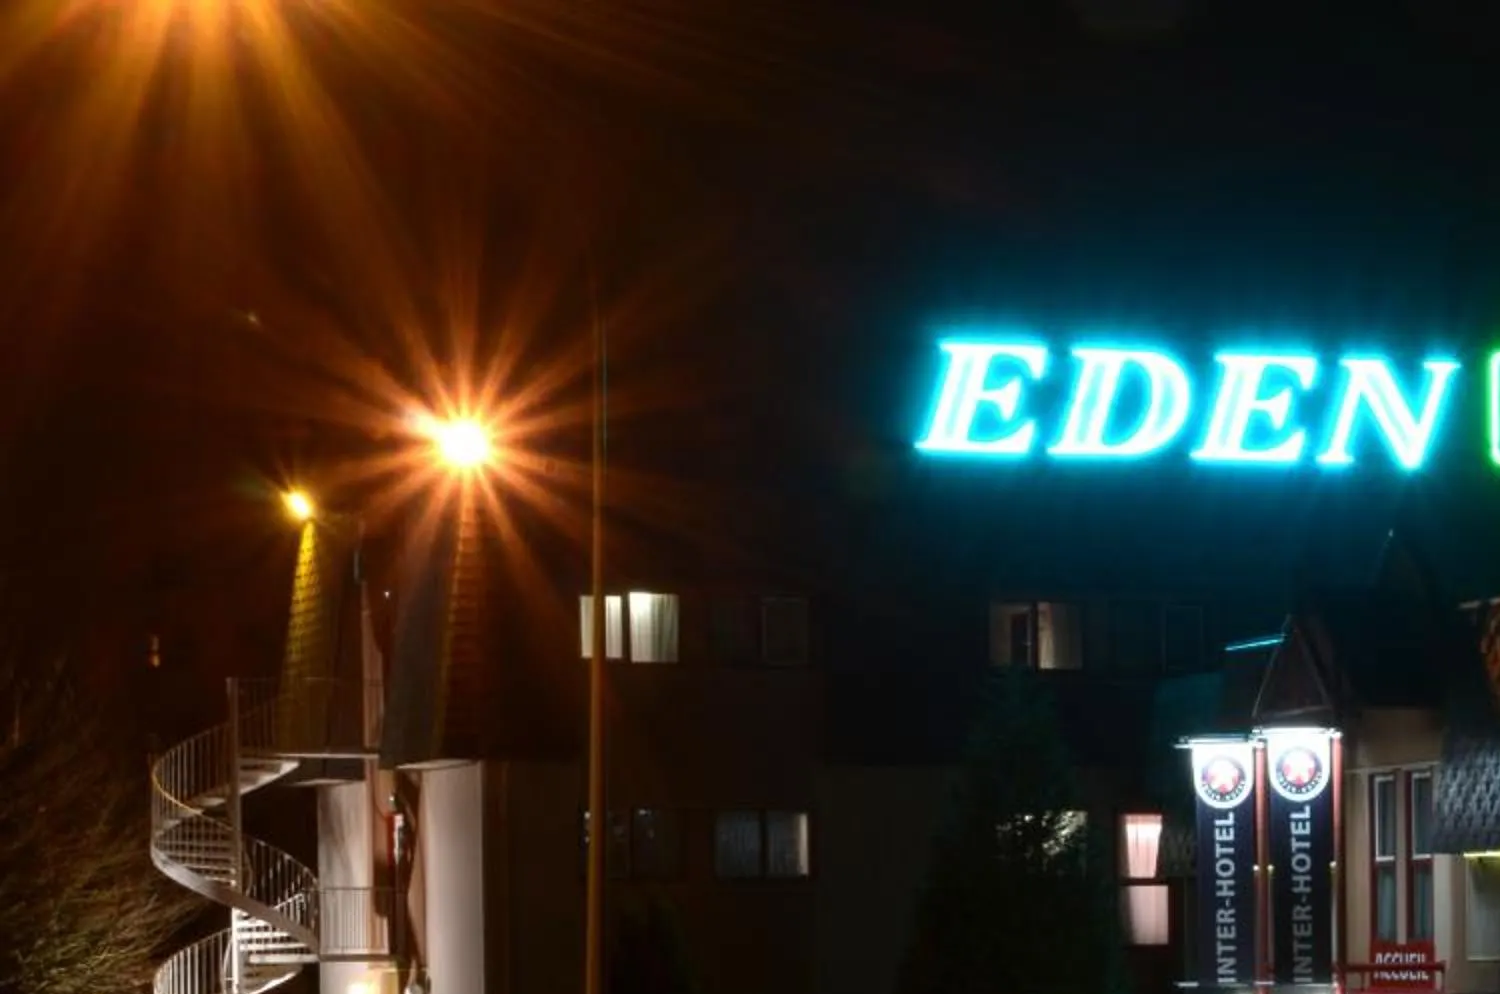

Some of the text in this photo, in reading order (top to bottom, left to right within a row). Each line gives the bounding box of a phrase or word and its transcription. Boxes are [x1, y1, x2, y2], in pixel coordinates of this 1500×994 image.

[914, 337, 1461, 469] EDEN
[1214, 810, 1237, 984] INTER-HOTEL
[1289, 804, 1314, 984] INTER-HOTEL
[1372, 951, 1430, 981] ACCUEIL
